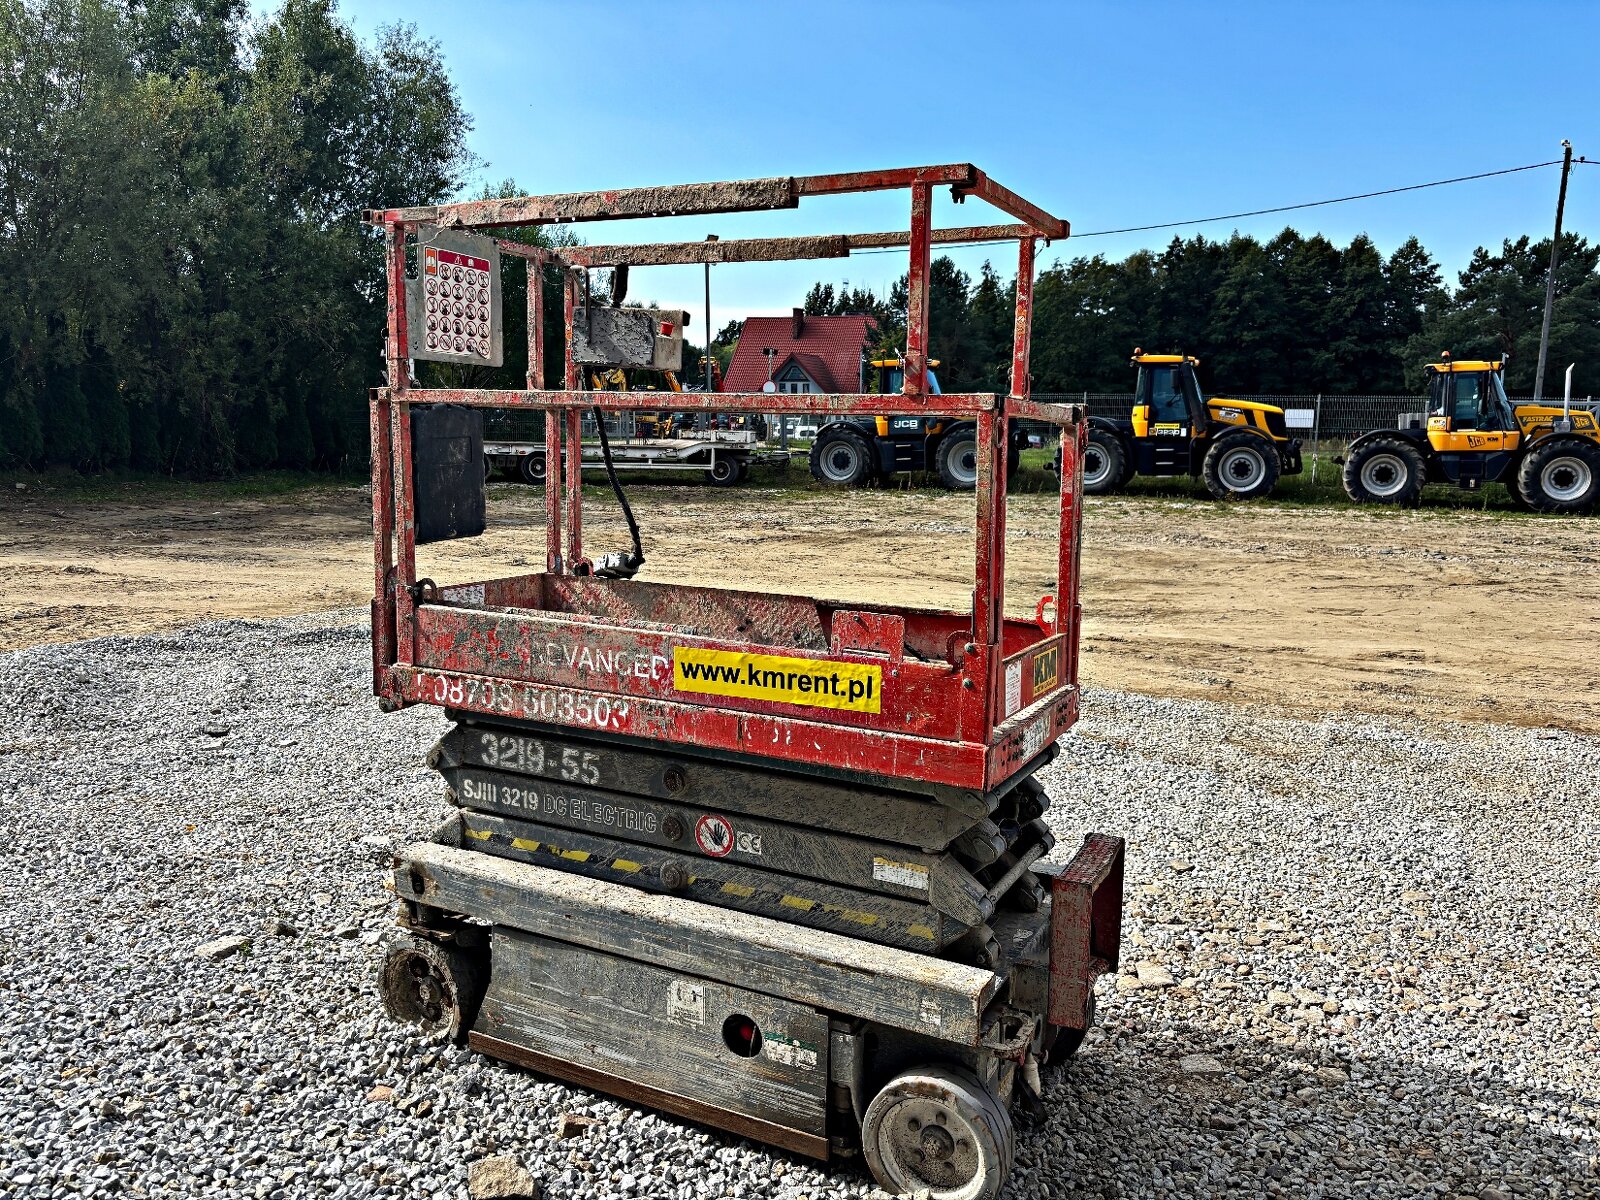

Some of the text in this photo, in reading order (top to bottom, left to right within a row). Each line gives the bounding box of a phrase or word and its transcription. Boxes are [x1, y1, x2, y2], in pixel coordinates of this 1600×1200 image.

[895, 420, 918, 428] JCB
[1467, 435, 1485, 448] JCB
[532, 642, 669, 680] DVANCED
[680, 661, 873, 703] www.kmrent.pl
[463, 779, 657, 834] SJIII 3219 DC ELECTRIC
